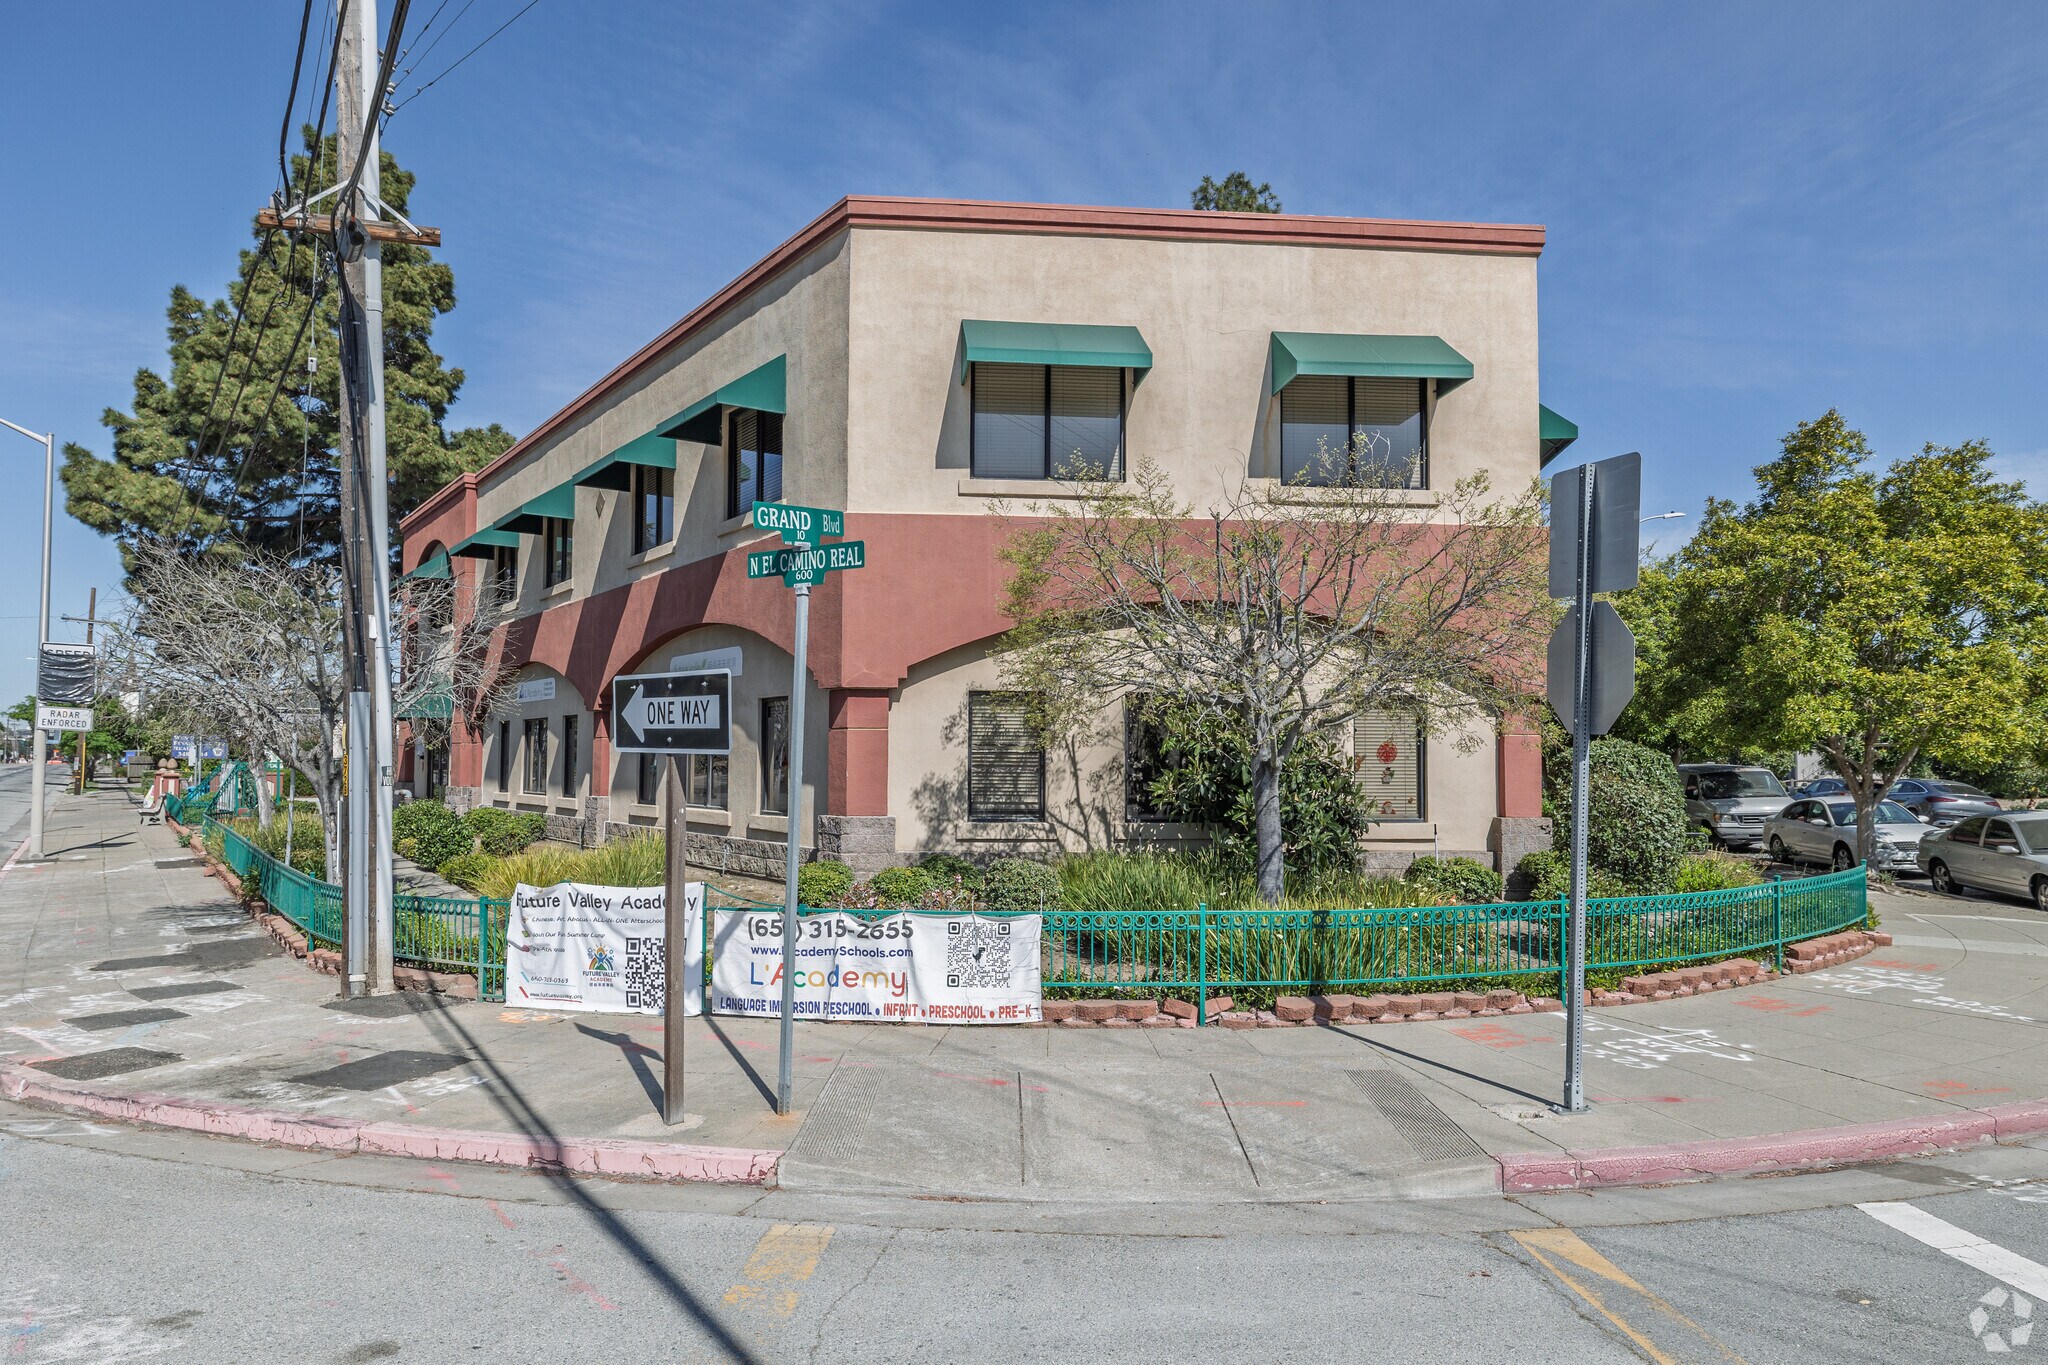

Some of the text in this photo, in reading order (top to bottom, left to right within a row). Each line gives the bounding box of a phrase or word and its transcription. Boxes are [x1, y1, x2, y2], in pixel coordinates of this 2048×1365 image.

[757, 506, 841, 534] GRAND Blvd
[796, 531, 805, 540] 10
[750, 546, 863, 576] N EL CAMINO REAL
[795, 570, 813, 581] 600
[50, 710, 80, 719] RADAR
[647, 700, 710, 725] ONE WAY
[41, 718, 87, 728] ENFORCED
[516, 892, 697, 911] Future Valley Acady
[748, 916, 914, 942] (65) 315-2655
[751, 945, 914, 959] www.cademySchools.com
[720, 996, 873, 1017] LANGUAGE IMRSION PESCHOOL
[883, 1003, 1033, 1019] INFANT PRESCHOOL PRE-K
